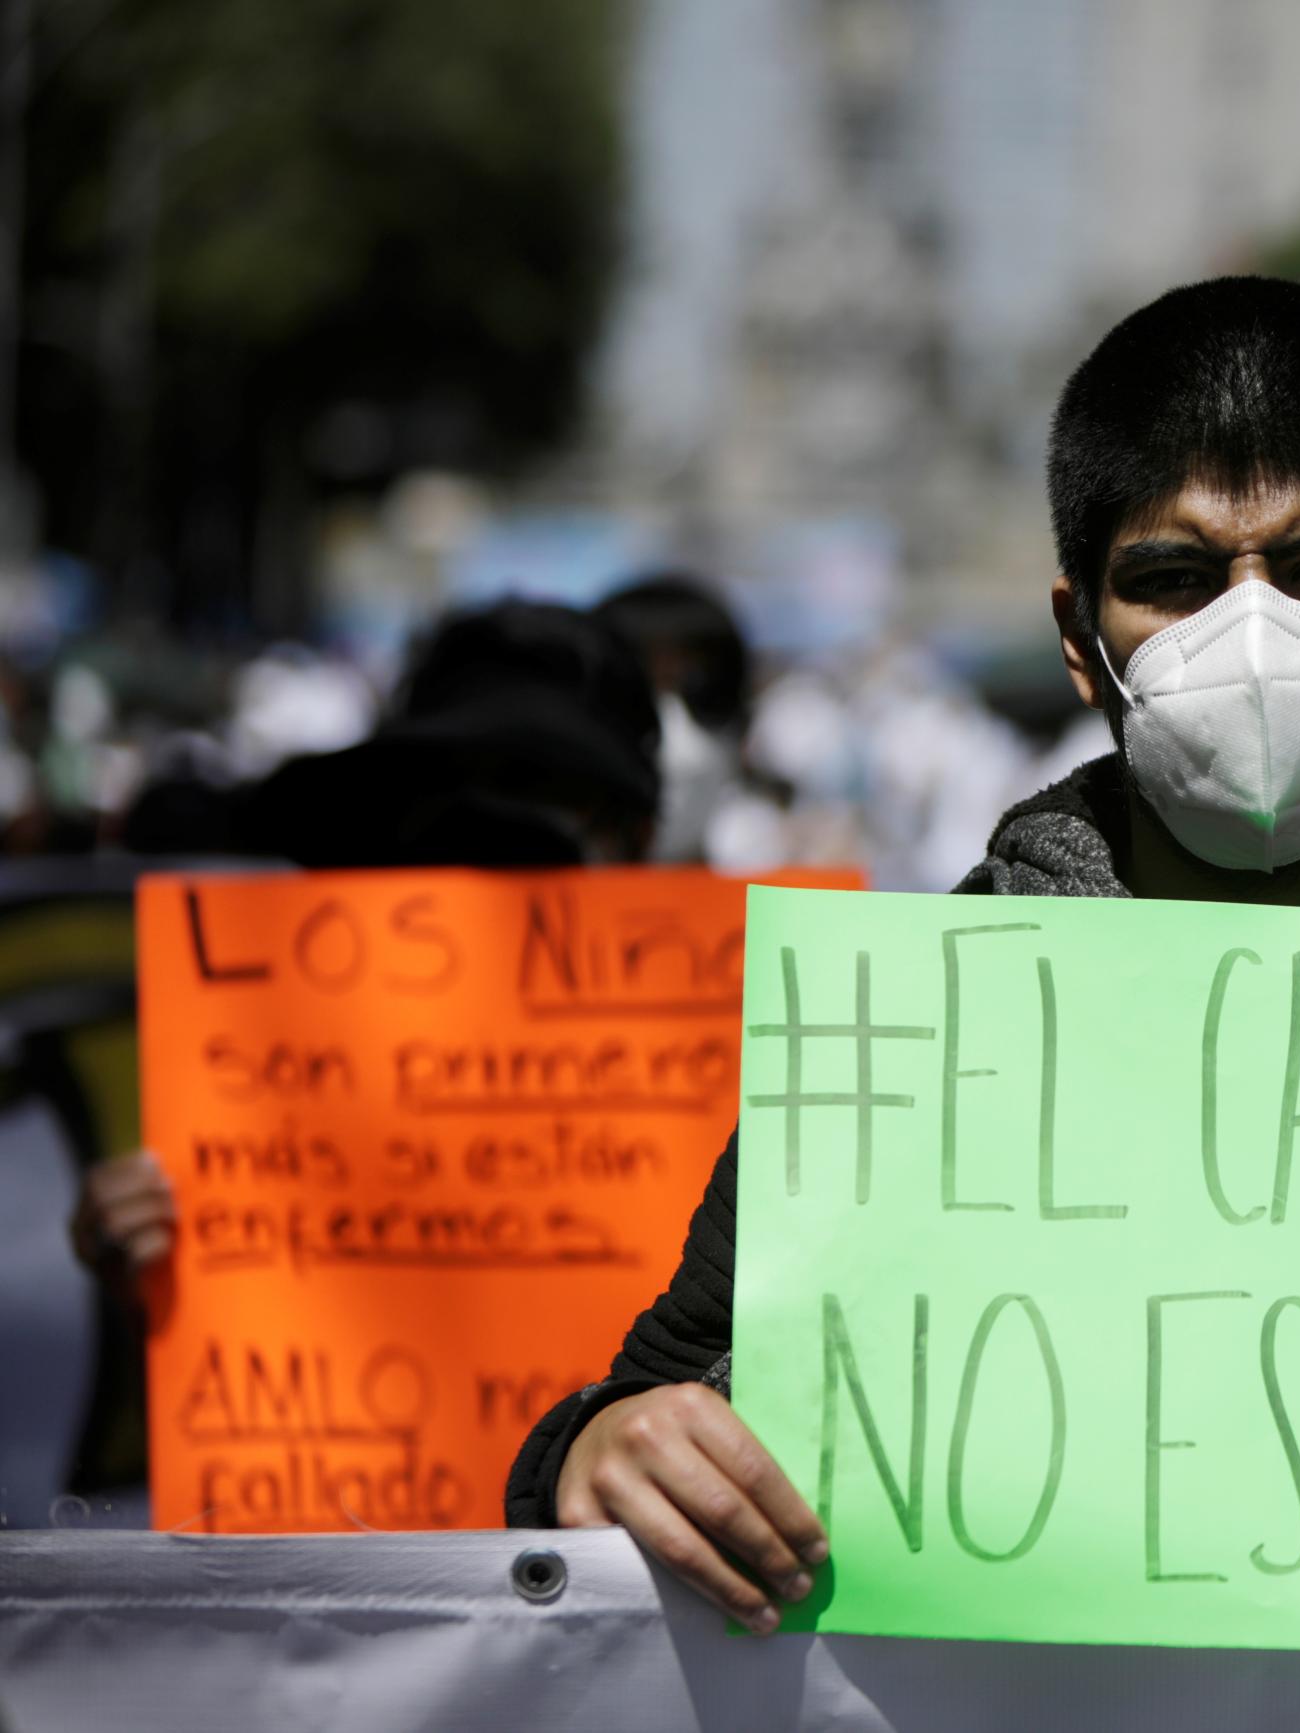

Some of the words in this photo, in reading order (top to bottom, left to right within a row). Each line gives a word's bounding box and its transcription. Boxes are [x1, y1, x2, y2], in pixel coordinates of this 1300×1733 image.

[184, 884, 464, 996] LOS
[746, 921, 1128, 1220] #EL
[180, 1335, 437, 1438] AMLO
[817, 1293, 1067, 1564] NO
